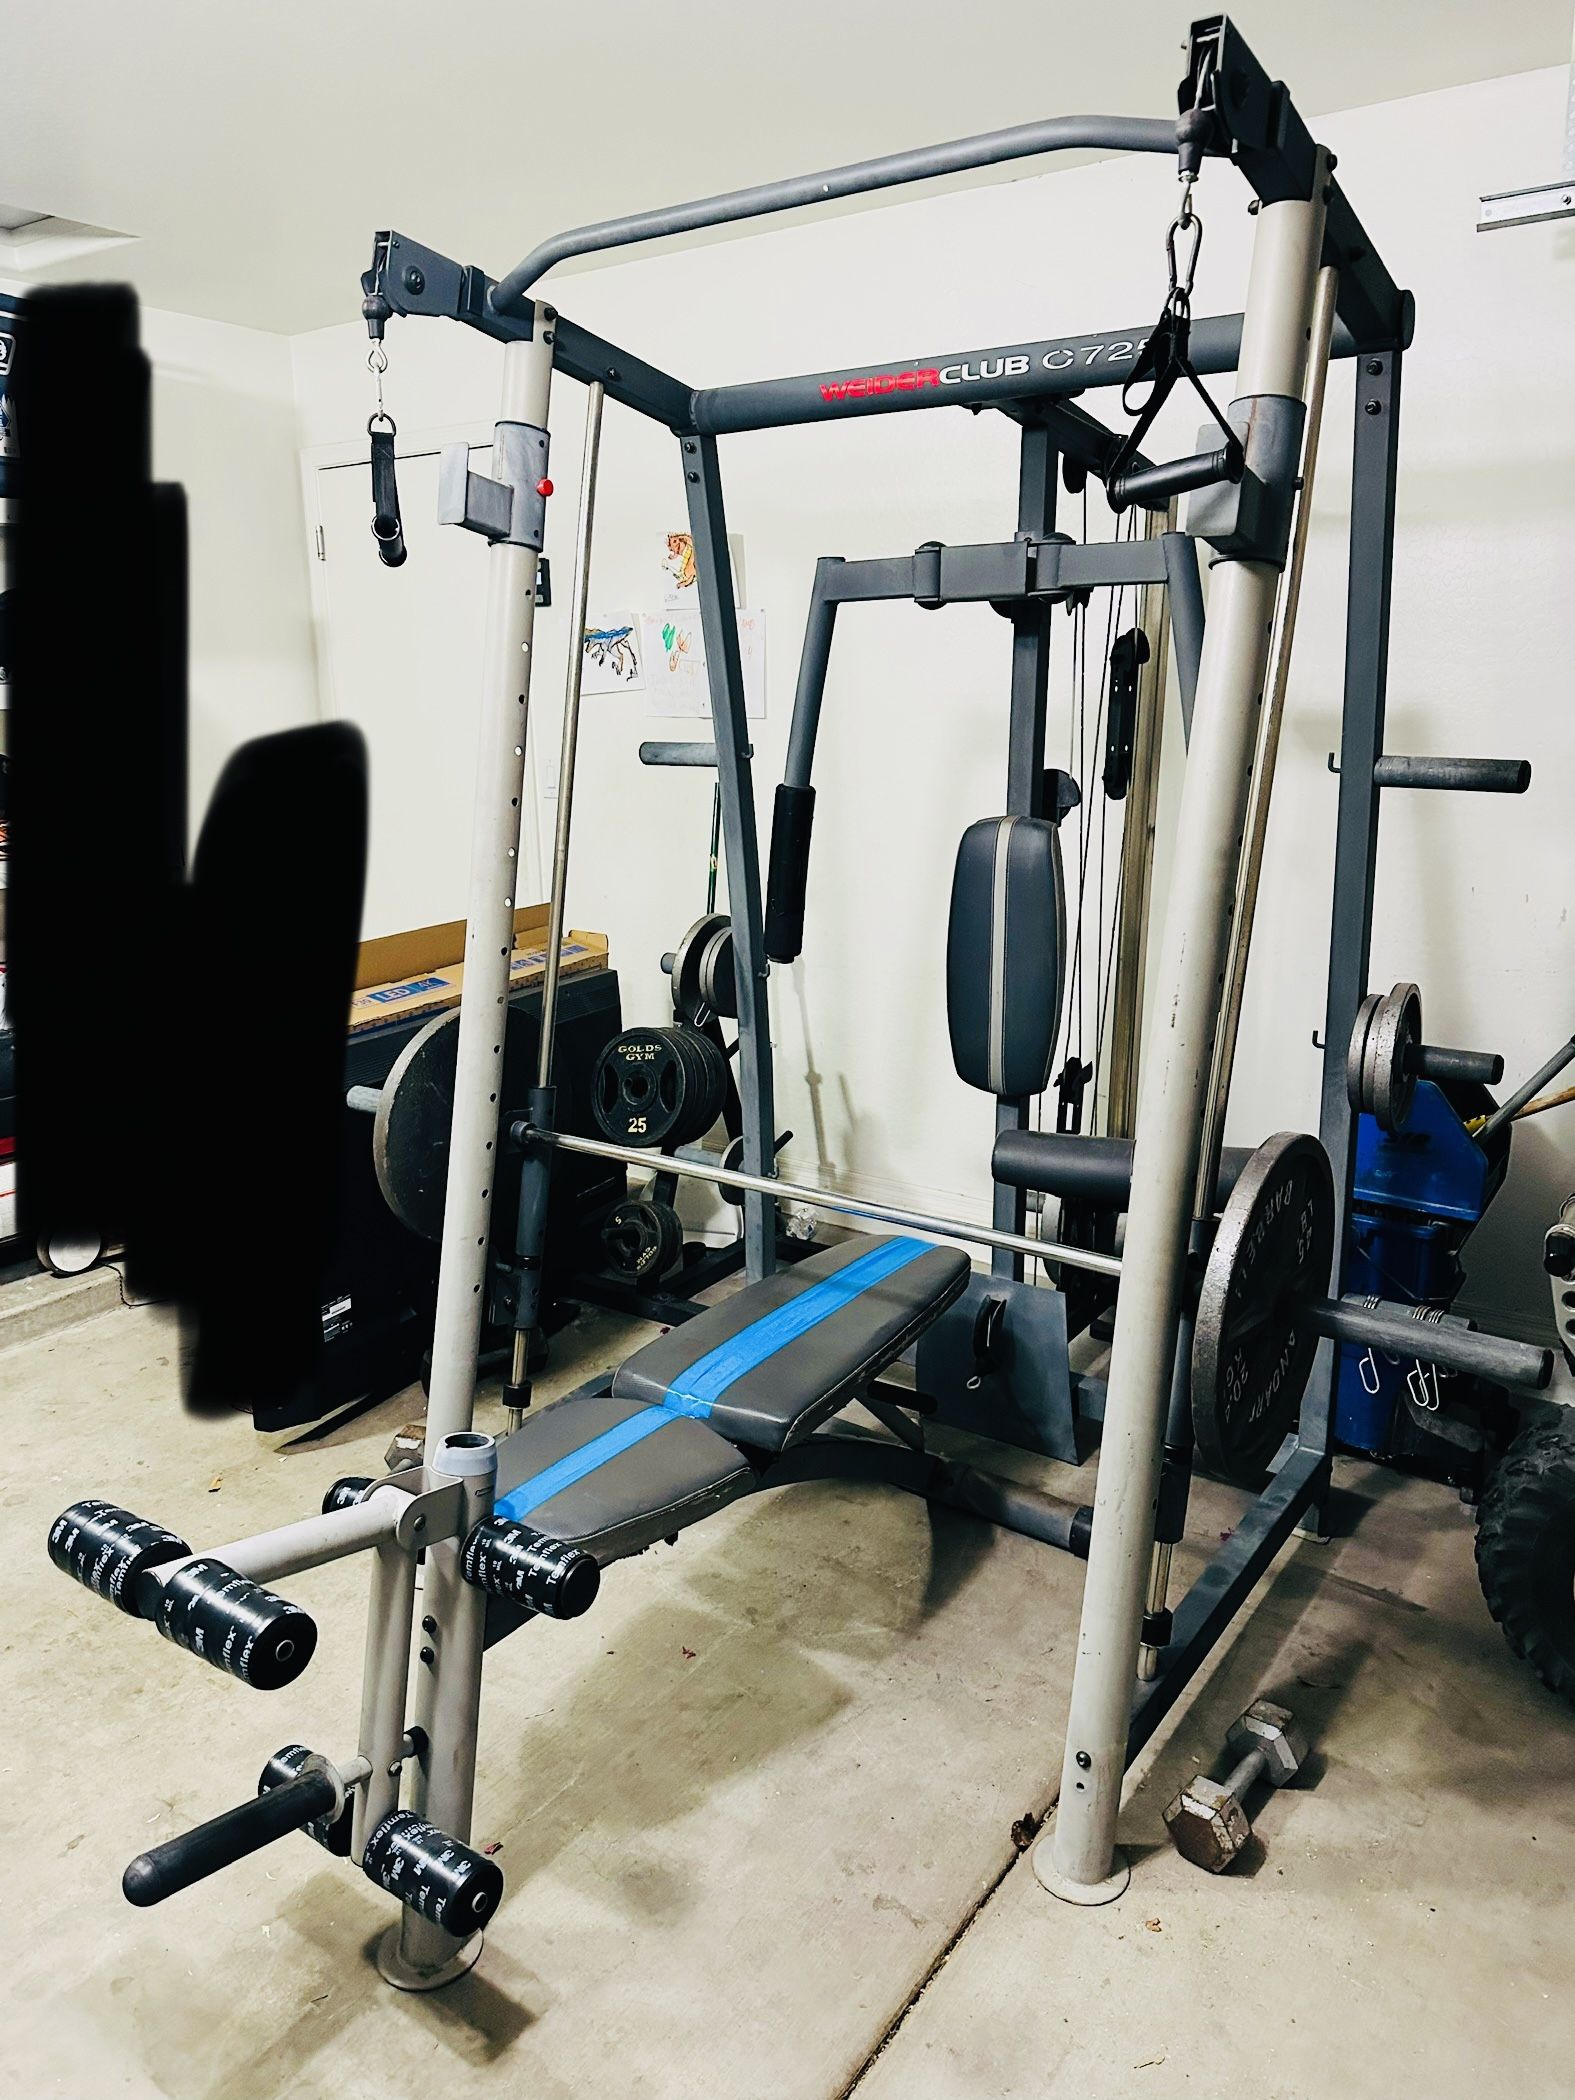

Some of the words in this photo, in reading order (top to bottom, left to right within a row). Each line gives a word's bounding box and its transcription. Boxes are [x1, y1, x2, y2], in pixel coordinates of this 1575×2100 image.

[375, 987, 412, 1001] LED
[618, 1044, 662, 1053] GOLDS
[625, 1053, 655, 1061] GYM
[628, 1117, 647, 1133] 25
[52, 1519, 68, 1544] 3M
[503, 1529, 522, 1544] 3M
[65, 1527, 80, 1553] 3M
[391, 1857, 405, 1880] 3M
